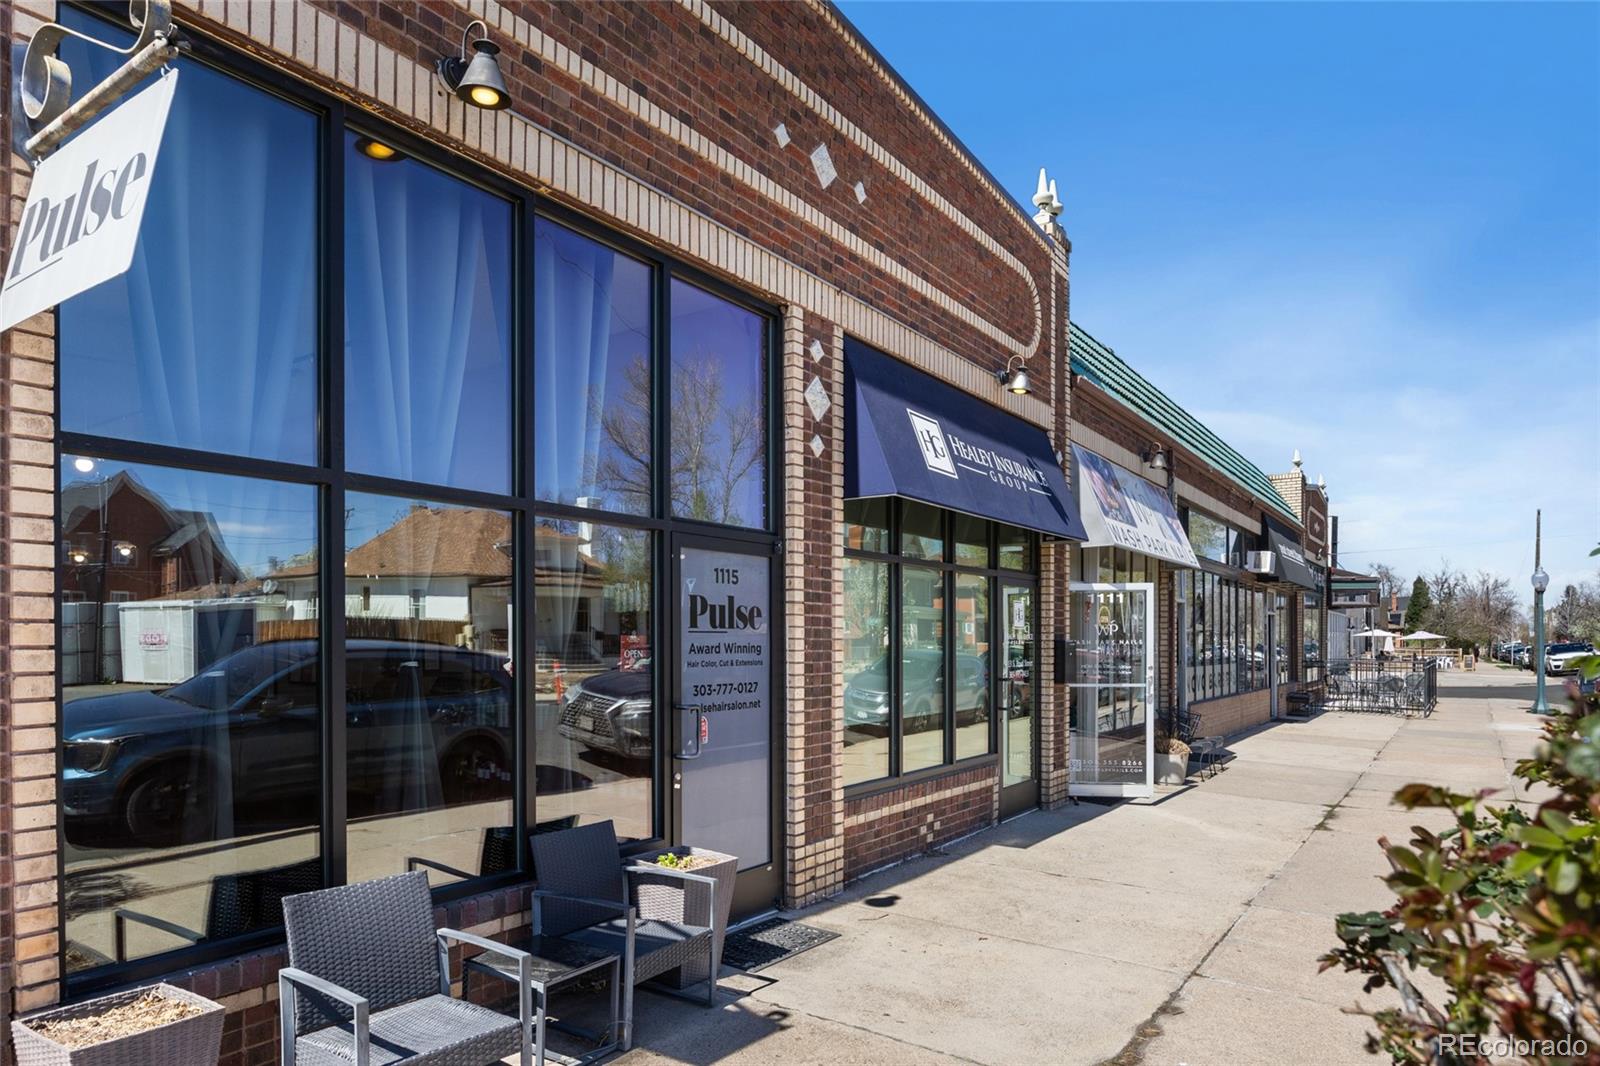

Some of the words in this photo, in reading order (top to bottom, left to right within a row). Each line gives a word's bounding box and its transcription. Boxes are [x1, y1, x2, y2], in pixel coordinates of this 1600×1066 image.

[9, 152, 147, 281] Pulse
[947, 433, 994, 468] HEALEY
[991, 451, 1048, 487] INSURANCE
[989, 470, 1028, 492] GROUP
[1107, 521, 1144, 551] WASH
[1143, 534, 1169, 554] PARK
[714, 567, 739, 585] 1115
[1088, 593, 1124, 604] 1111
[688, 594, 762, 631] Pulse
[623, 649, 644, 659] OPEN
[688, 642, 721, 655] Award
[724, 642, 762, 656] Winning
[687, 660, 699, 668] Hair
[701, 660, 718, 668] Color,
[719, 659, 729, 667] Cut
[735, 659, 763, 667] Extensions
[693, 681, 759, 697] 303-777-0127
[690, 699, 761, 714] lsehairsalon.net
